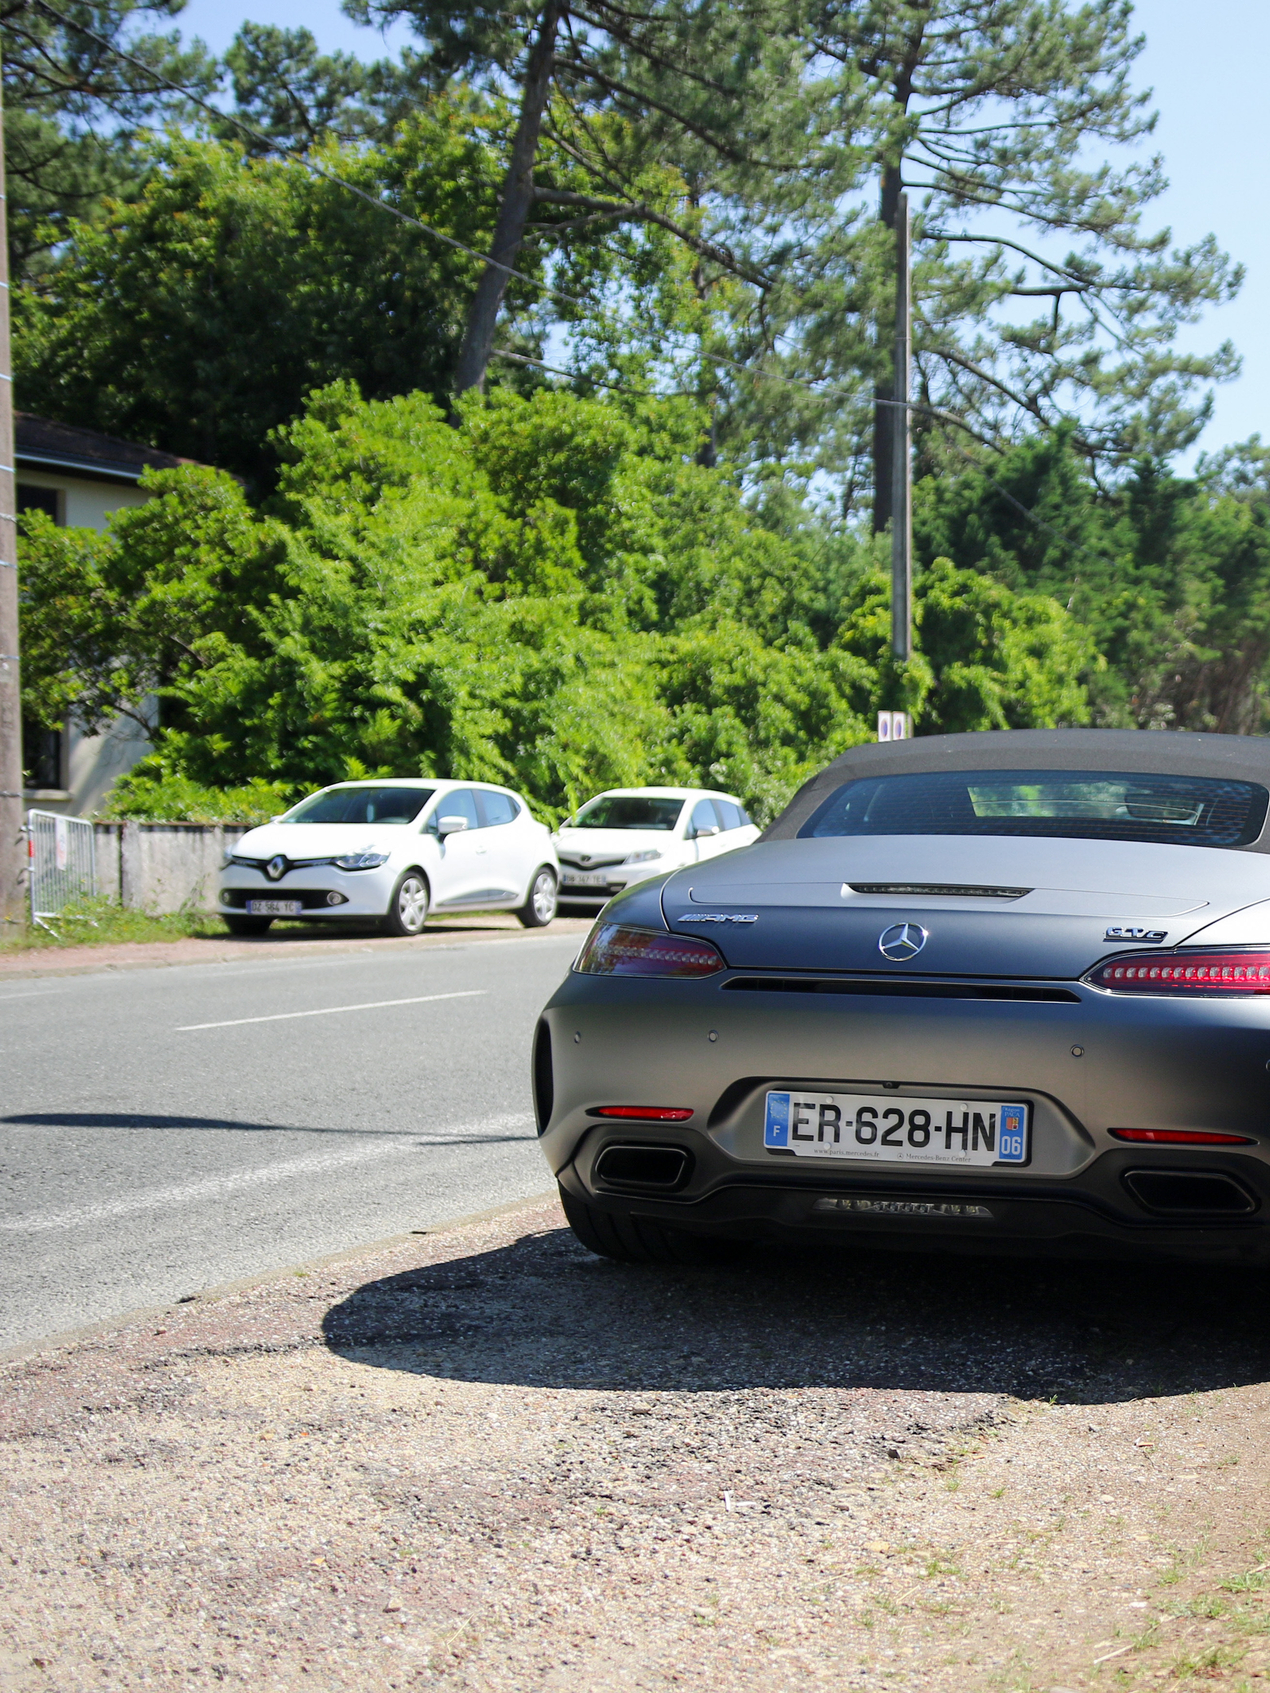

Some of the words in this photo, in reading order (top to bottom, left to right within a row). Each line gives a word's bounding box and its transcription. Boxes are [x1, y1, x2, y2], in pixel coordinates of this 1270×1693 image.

[700, 913, 759, 923] AMG
[773, 1125, 781, 1137] F
[791, 1102, 996, 1152] ER-628-HN
[1001, 1135, 1022, 1155] 06
[905, 1153, 950, 1162] Mercedes-Benz
